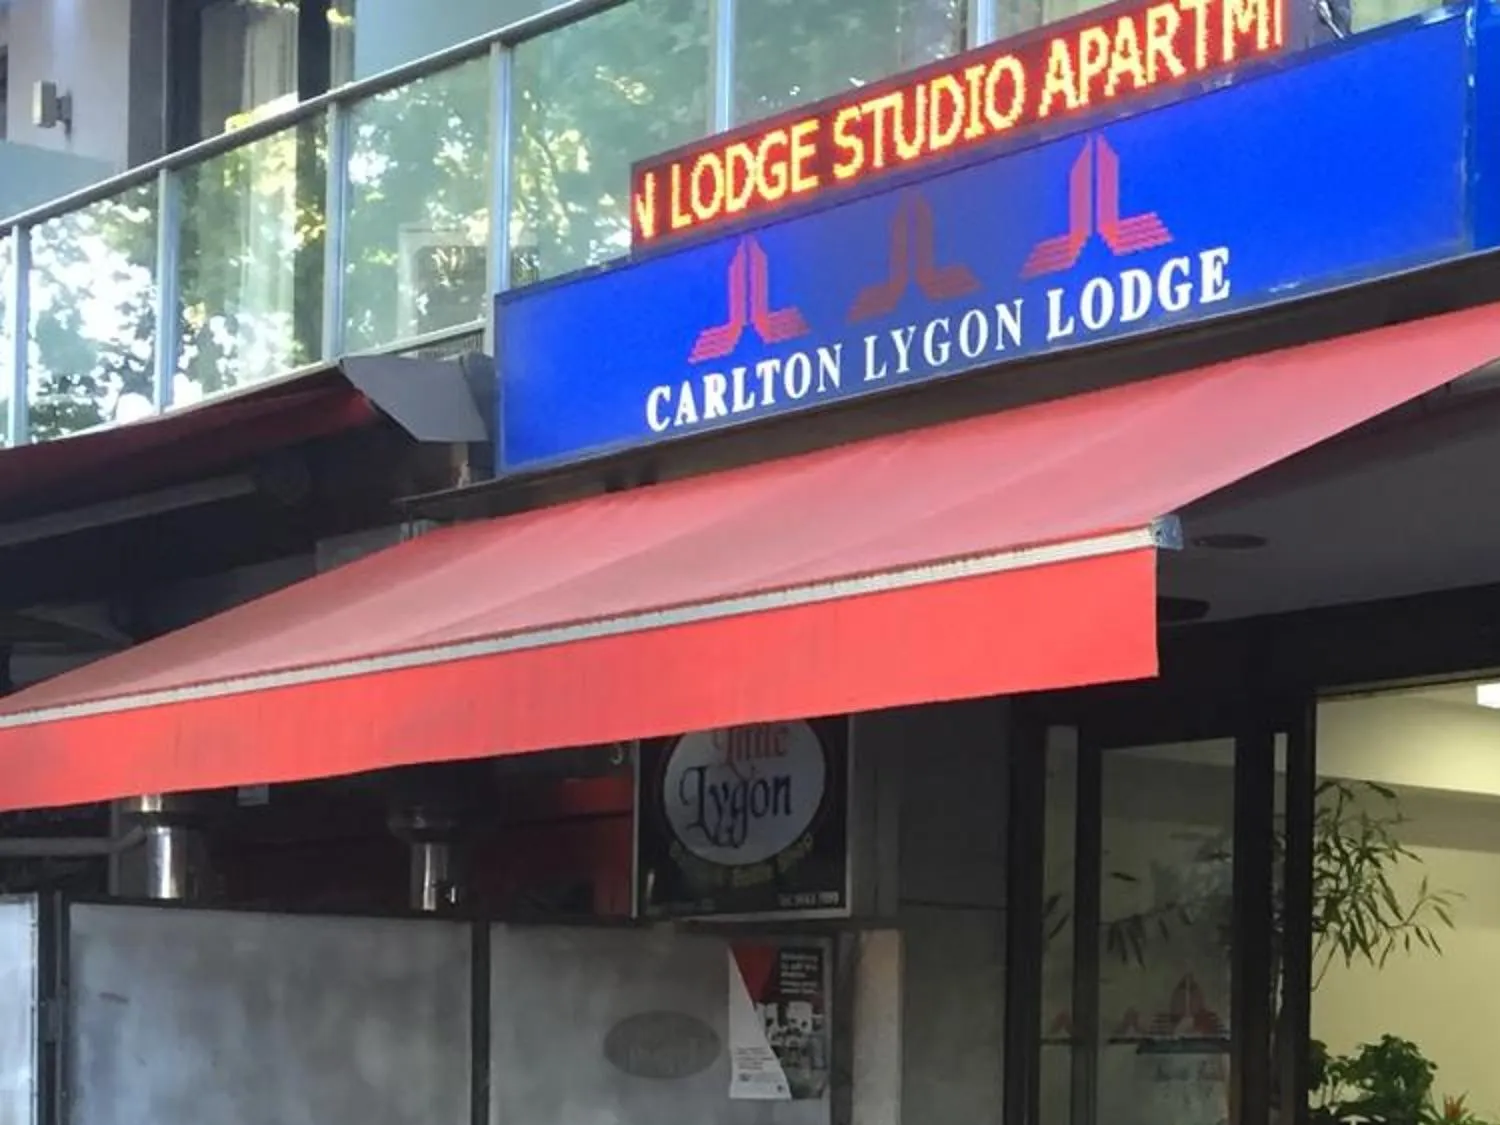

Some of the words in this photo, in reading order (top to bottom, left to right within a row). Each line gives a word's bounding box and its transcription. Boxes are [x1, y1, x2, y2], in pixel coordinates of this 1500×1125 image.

[670, 118, 820, 230] LODGE
[832, 54, 1026, 180] STUDIO
[645, 342, 844, 432] CARLTON
[863, 299, 1023, 382] LYGON
[1046, 246, 1231, 342] LODGE
[679, 765, 793, 848] Lygon
